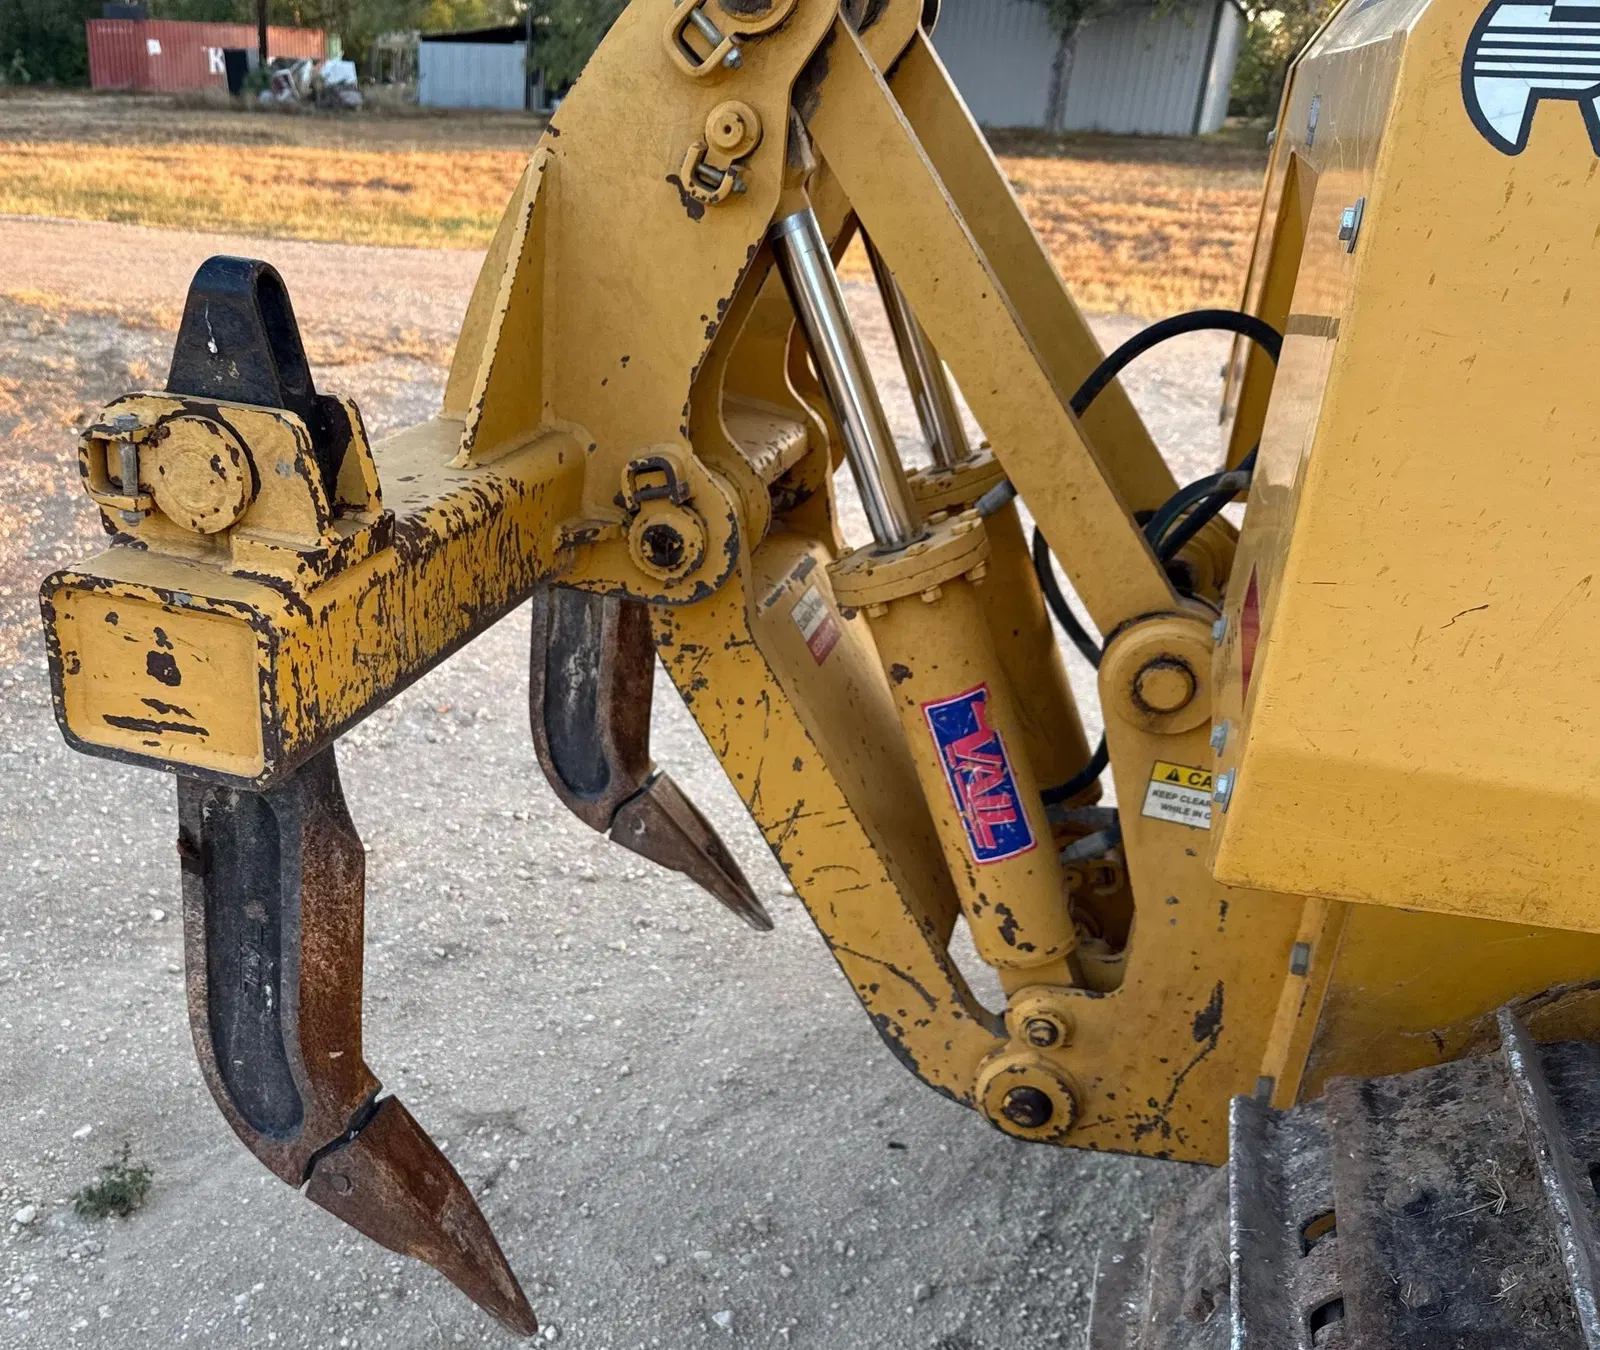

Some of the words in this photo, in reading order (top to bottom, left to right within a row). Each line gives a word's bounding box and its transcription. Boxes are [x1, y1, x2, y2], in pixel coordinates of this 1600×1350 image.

[208, 46, 226, 73] K
[947, 701, 1018, 849] VAIL
[1152, 789, 1178, 800] KEEP
[1161, 803, 1191, 815] WHILE
[1192, 810, 1203, 818] IN
